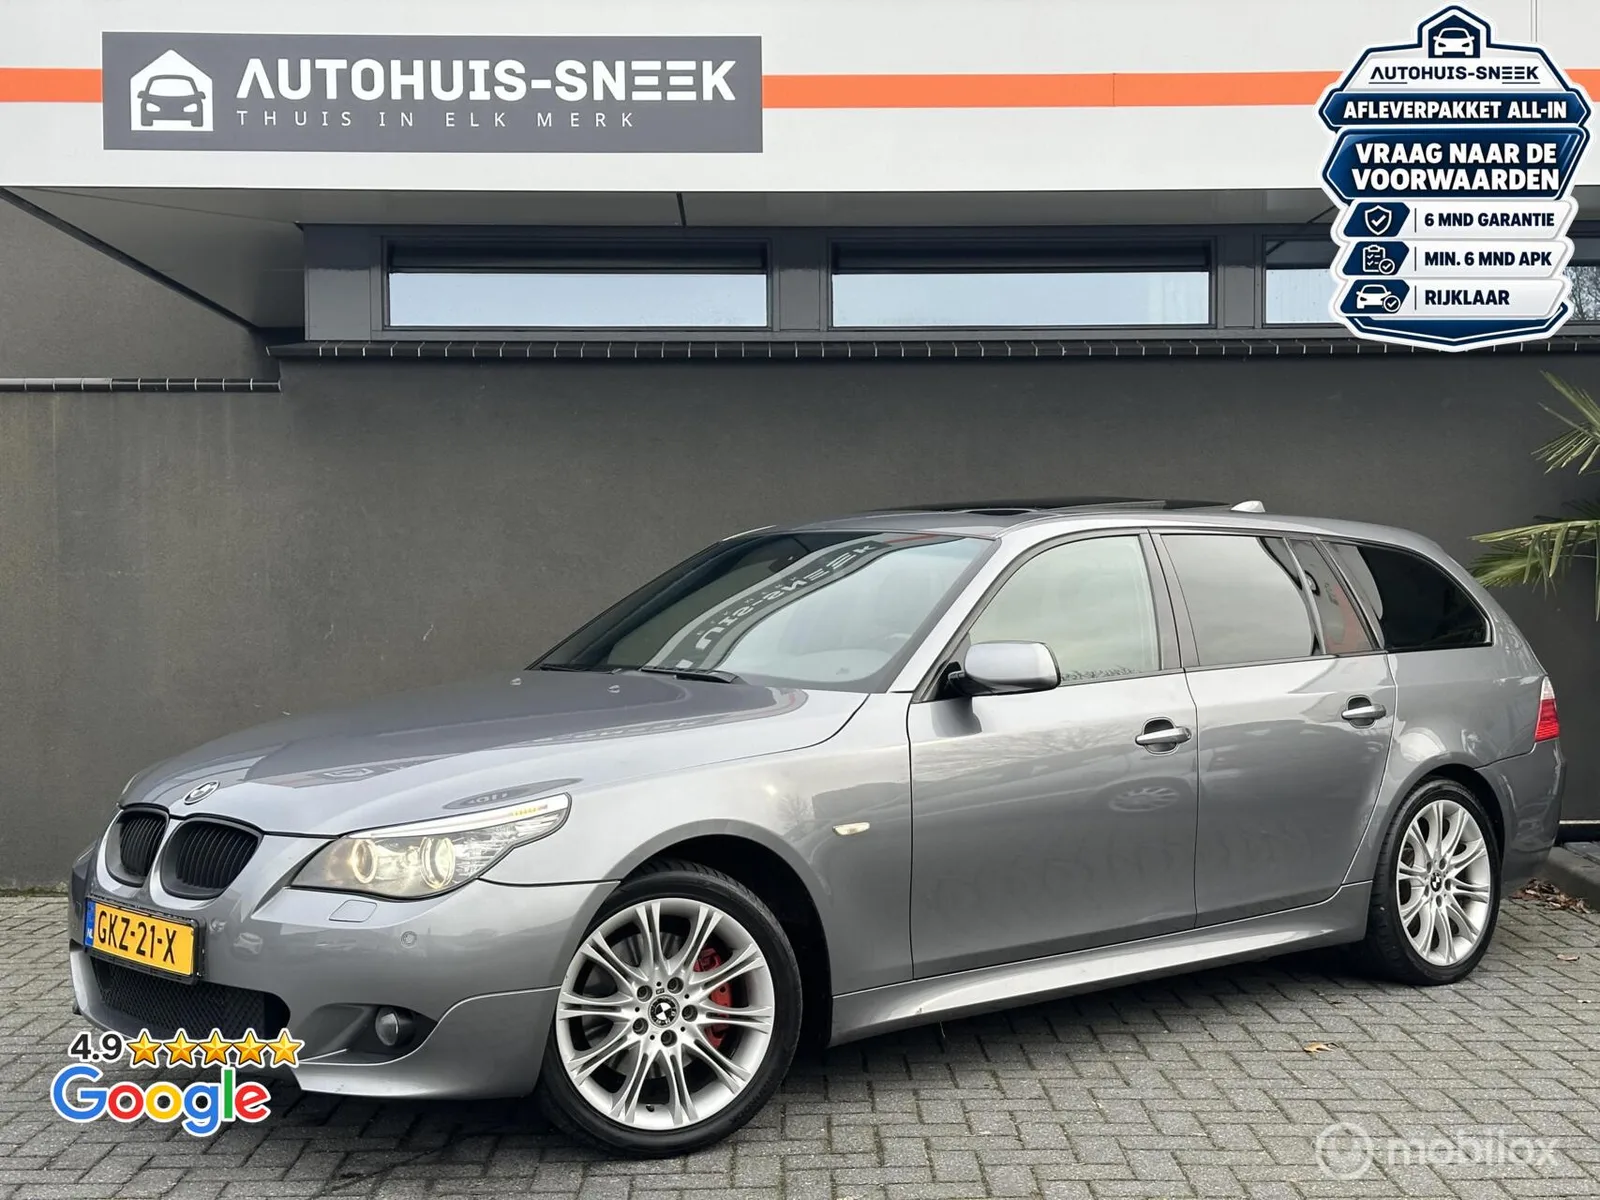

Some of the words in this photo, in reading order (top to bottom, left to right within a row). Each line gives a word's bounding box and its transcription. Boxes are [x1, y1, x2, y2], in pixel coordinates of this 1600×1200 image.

[236, 58, 736, 102] AUTOHUIS-SNEEK
[236, 110, 352, 127] THUIS
[379, 111, 413, 127] IN
[445, 112, 506, 128] ELK
[537, 112, 634, 128] MERK
[97, 910, 177, 965] GKZ-21-X
